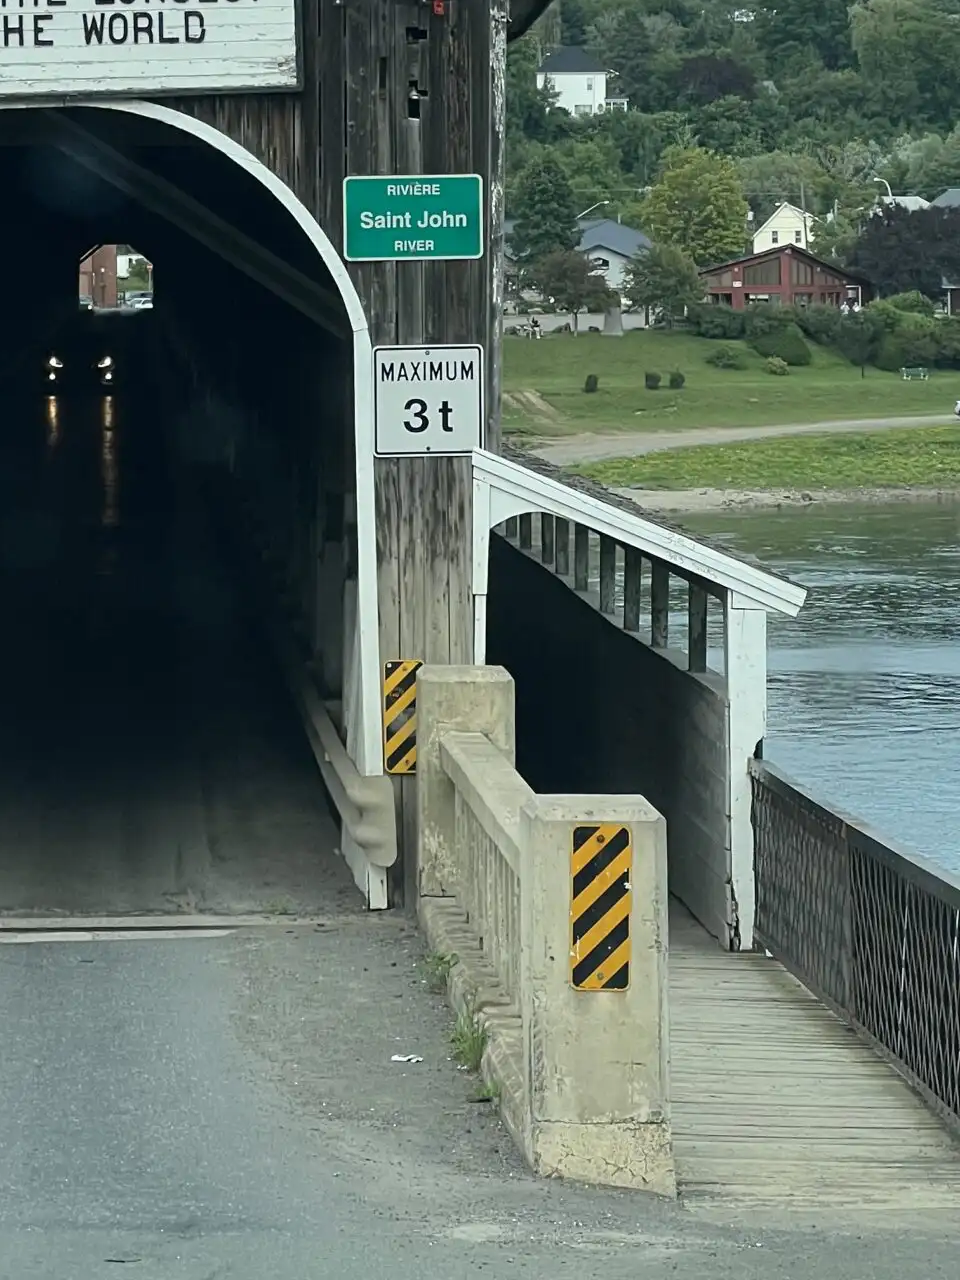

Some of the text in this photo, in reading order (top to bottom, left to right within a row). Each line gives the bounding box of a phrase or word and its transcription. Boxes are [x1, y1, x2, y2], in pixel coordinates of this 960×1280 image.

[83, 11, 205, 45] WORLD
[387, 181, 440, 195] RIVIÈRE
[361, 211, 466, 228] Saint John
[395, 240, 434, 251] RIVER
[382, 361, 473, 381] MAXIMUM
[404, 399, 453, 432] 3 t
